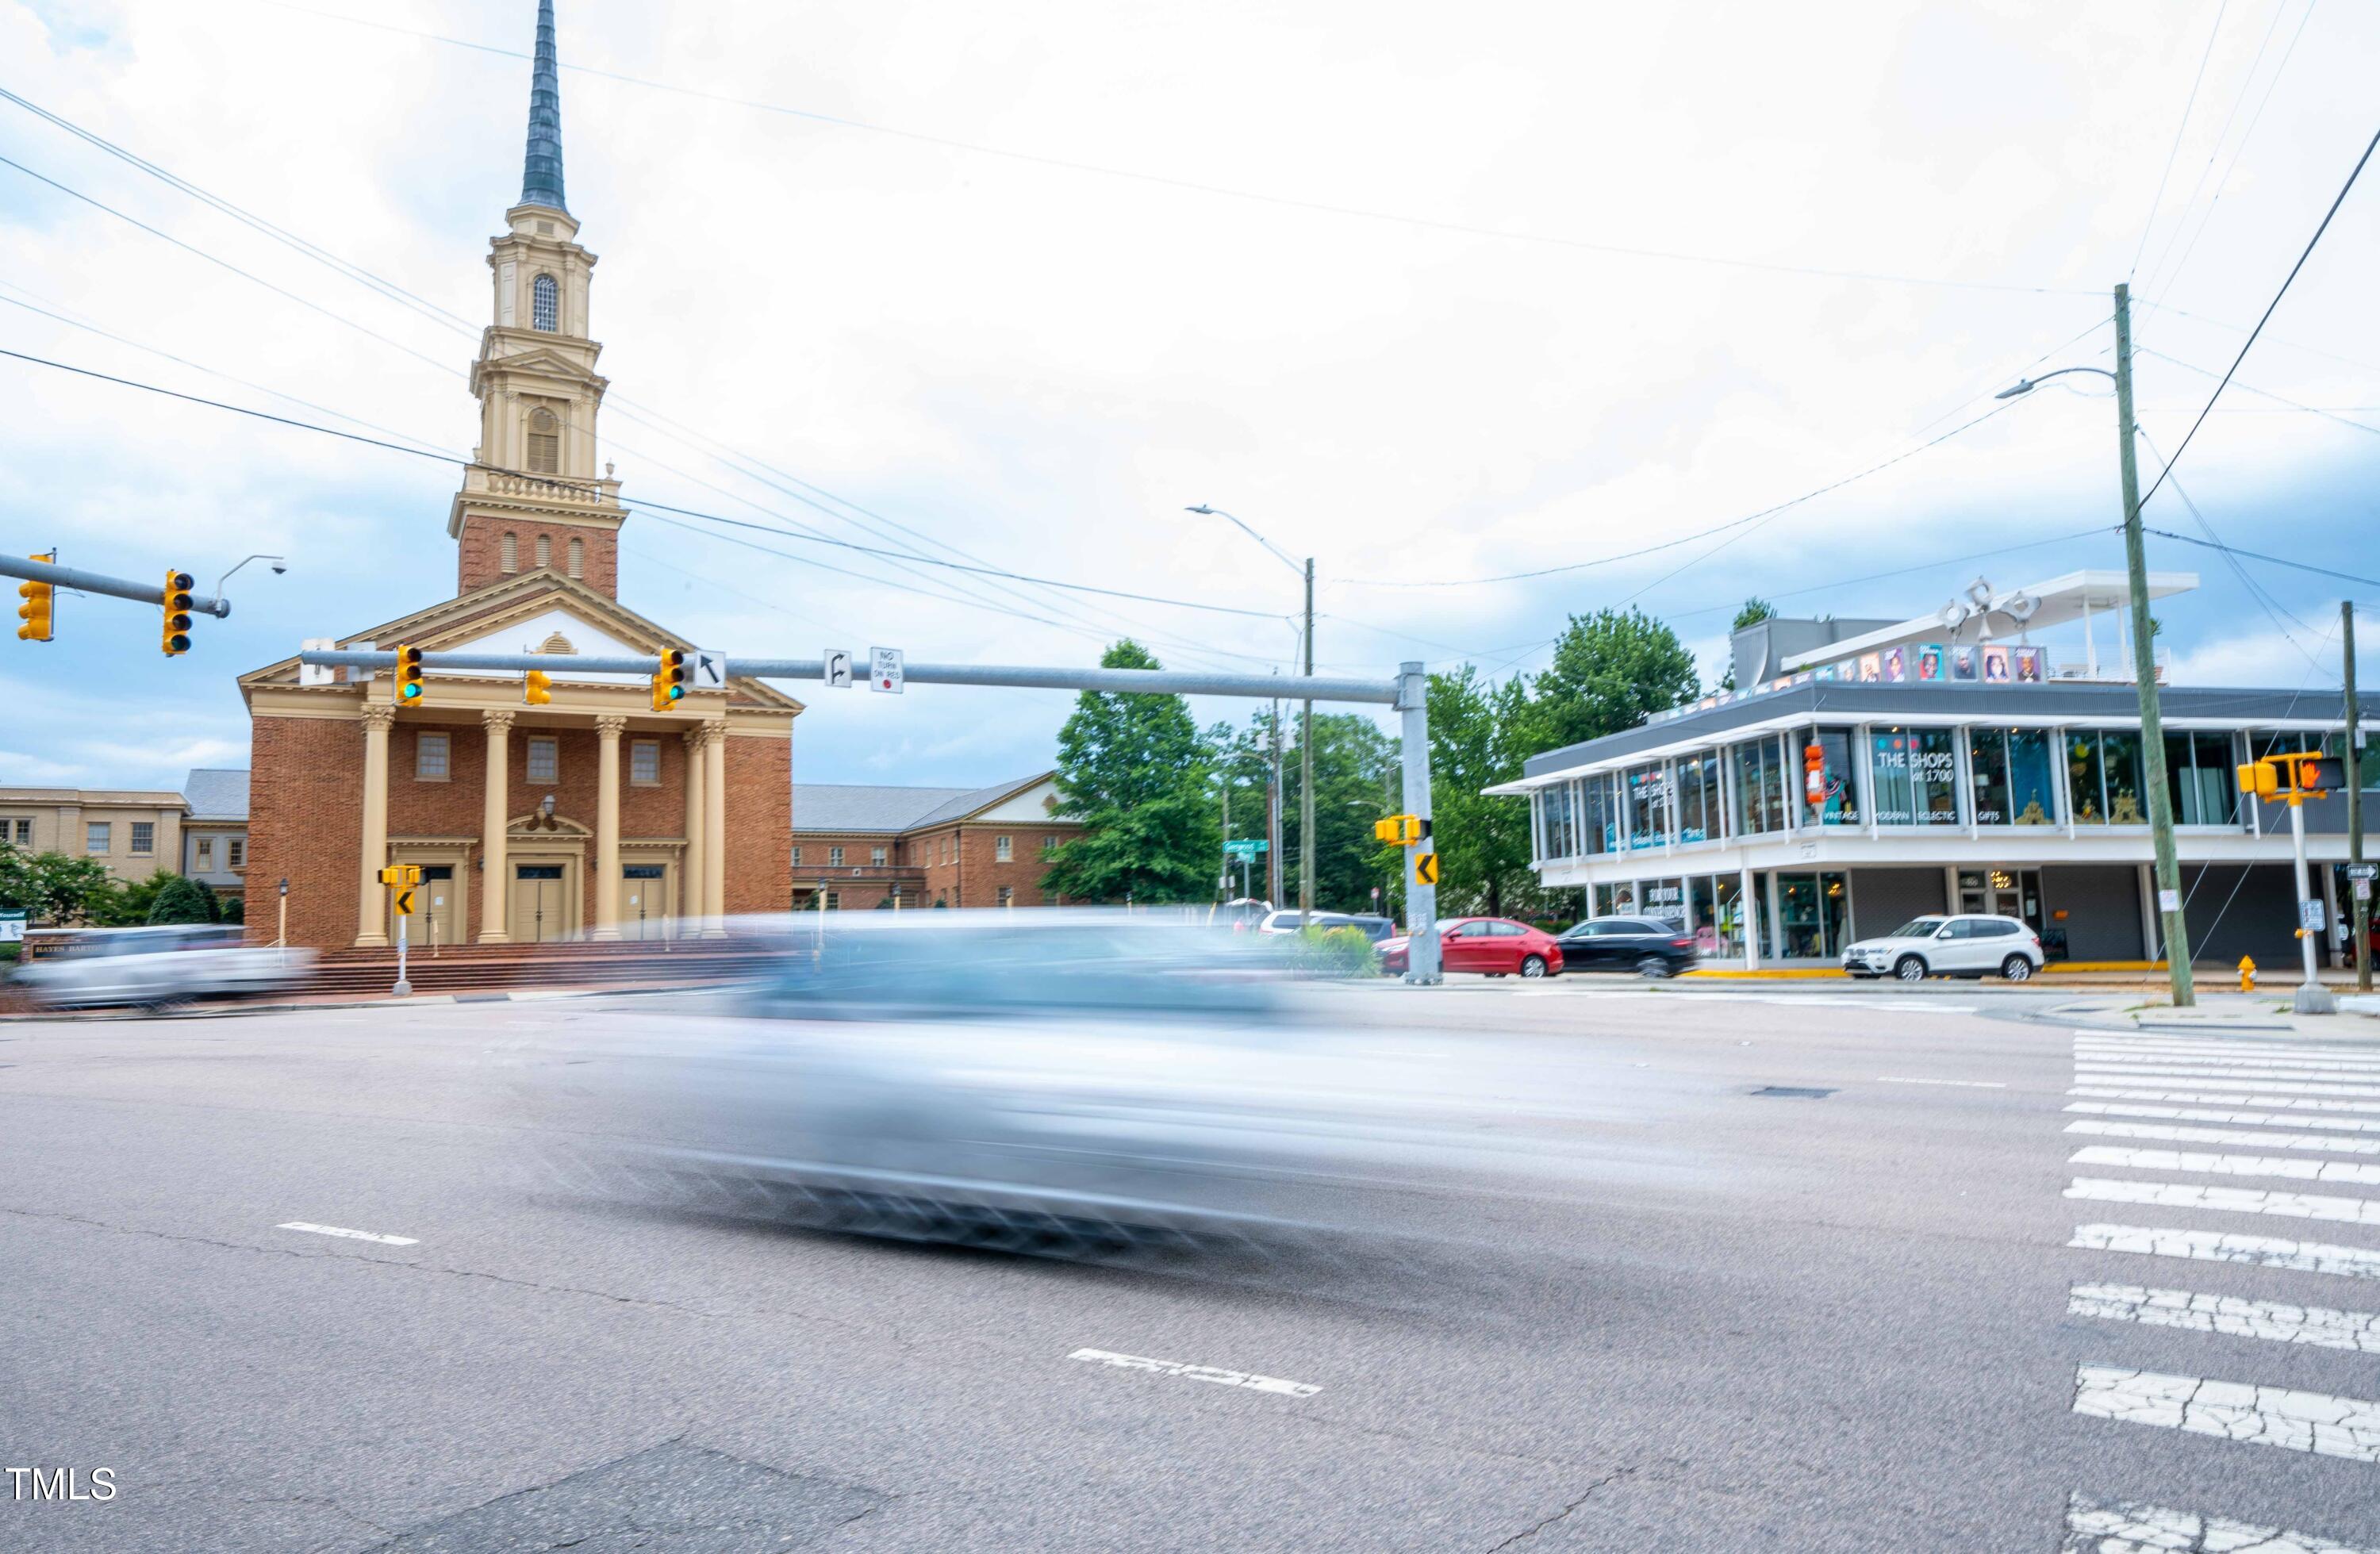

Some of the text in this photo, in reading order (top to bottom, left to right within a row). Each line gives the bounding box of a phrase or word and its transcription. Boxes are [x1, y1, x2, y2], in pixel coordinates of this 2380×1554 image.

[880, 650, 895, 661] NO
[1878, 751, 1954, 769] THE SHOPS
[1910, 769, 1955, 782] at 1700
[1633, 785, 1648, 800] THE
[1824, 810, 1860, 821] VINTAGE
[1917, 811, 1956, 821] ECLECTIC
[1977, 811, 2001, 821] GIFTS
